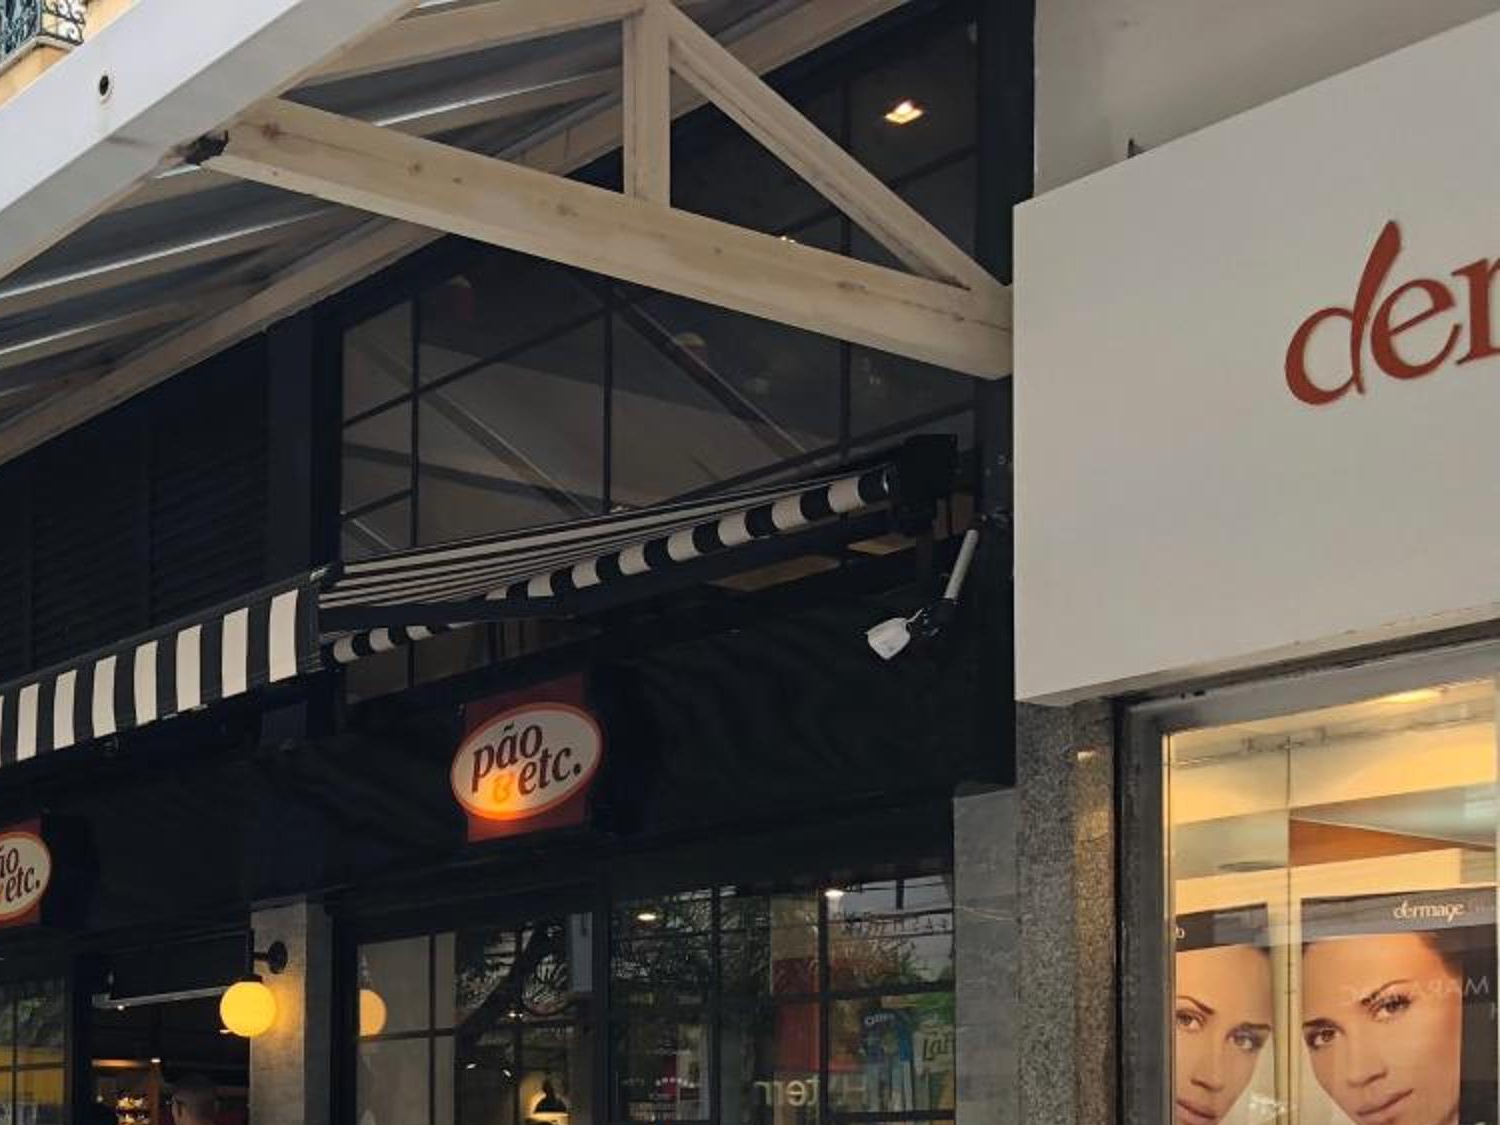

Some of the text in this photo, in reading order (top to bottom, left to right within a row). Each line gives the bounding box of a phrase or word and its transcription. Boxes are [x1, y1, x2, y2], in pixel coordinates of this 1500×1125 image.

[471, 721, 543, 793] pão
[517, 747, 582, 796] etc.
[5, 867, 41, 903] etc.
[1394, 899, 1466, 922] dermage
